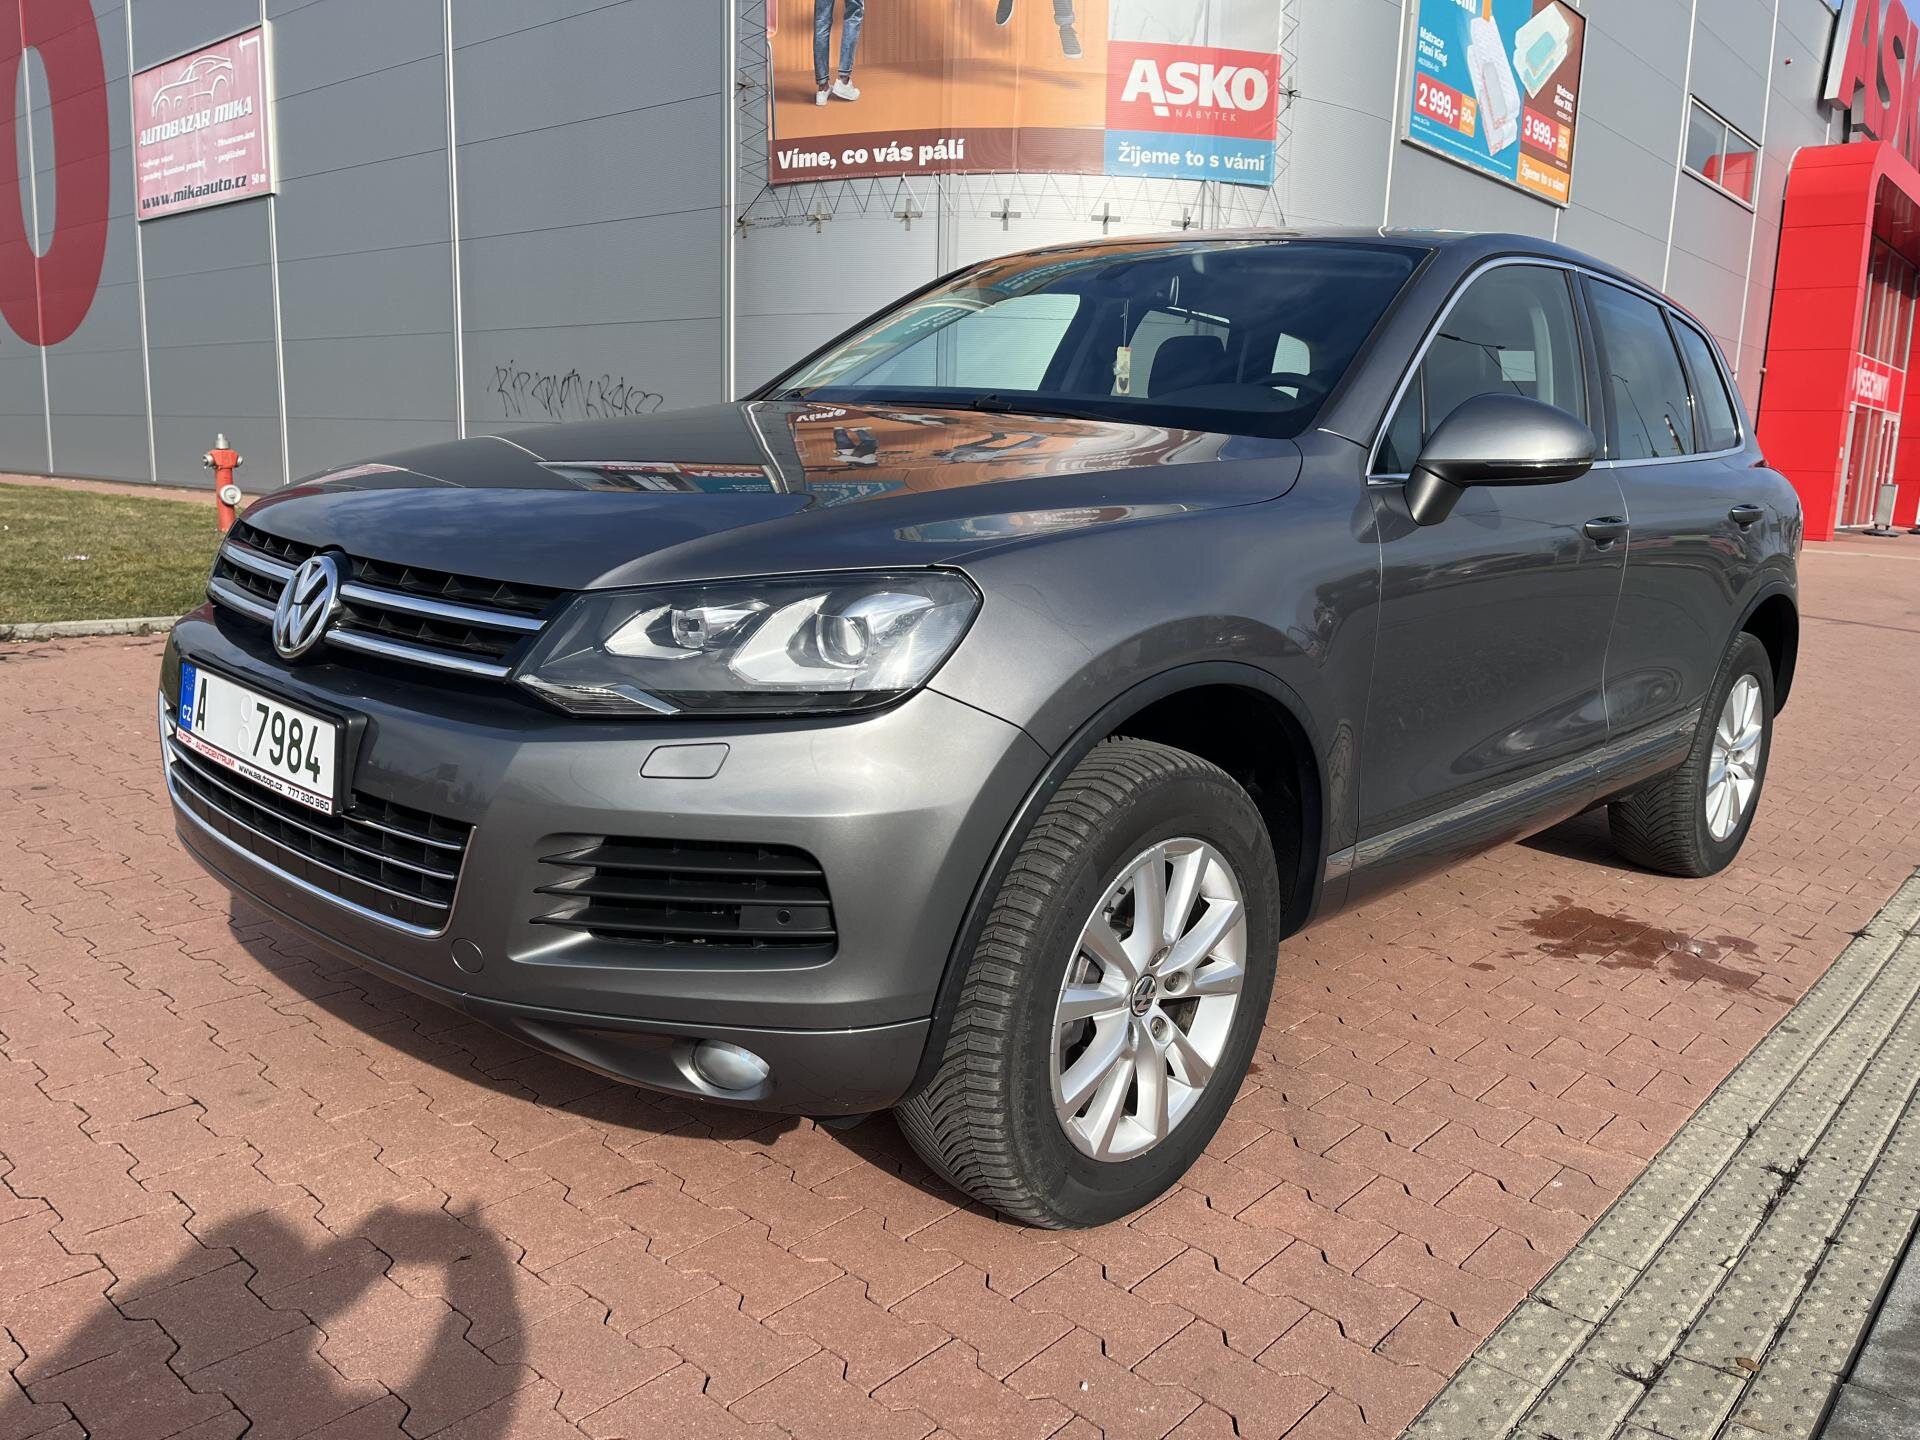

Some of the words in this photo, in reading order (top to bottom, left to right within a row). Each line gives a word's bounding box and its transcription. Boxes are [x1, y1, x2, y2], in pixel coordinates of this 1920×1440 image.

[1120, 59, 1269, 113] ASKO
[139, 109, 211, 147] AUTOBAZAR
[213, 95, 253, 125] MIKA
[1175, 108, 1237, 123] NÁBYTEK
[777, 148, 837, 170] Víme,
[842, 149, 869, 165] co
[872, 141, 914, 163] vás
[918, 138, 965, 166] pálí
[1117, 141, 1181, 167] Žijeme
[1185, 150, 1204, 166] to
[1209, 154, 1219, 168] s
[1224, 152, 1266, 171] vámi
[142, 175, 247, 209] www.mikaauto.cz
[182, 704, 192, 722] CZ
[195, 677, 208, 731] A
[252, 702, 321, 784] 7984
[195, 741, 235, 768] AUTOCENTRUM
[287, 786, 300, 799] 777
[300, 792, 315, 806] 330
